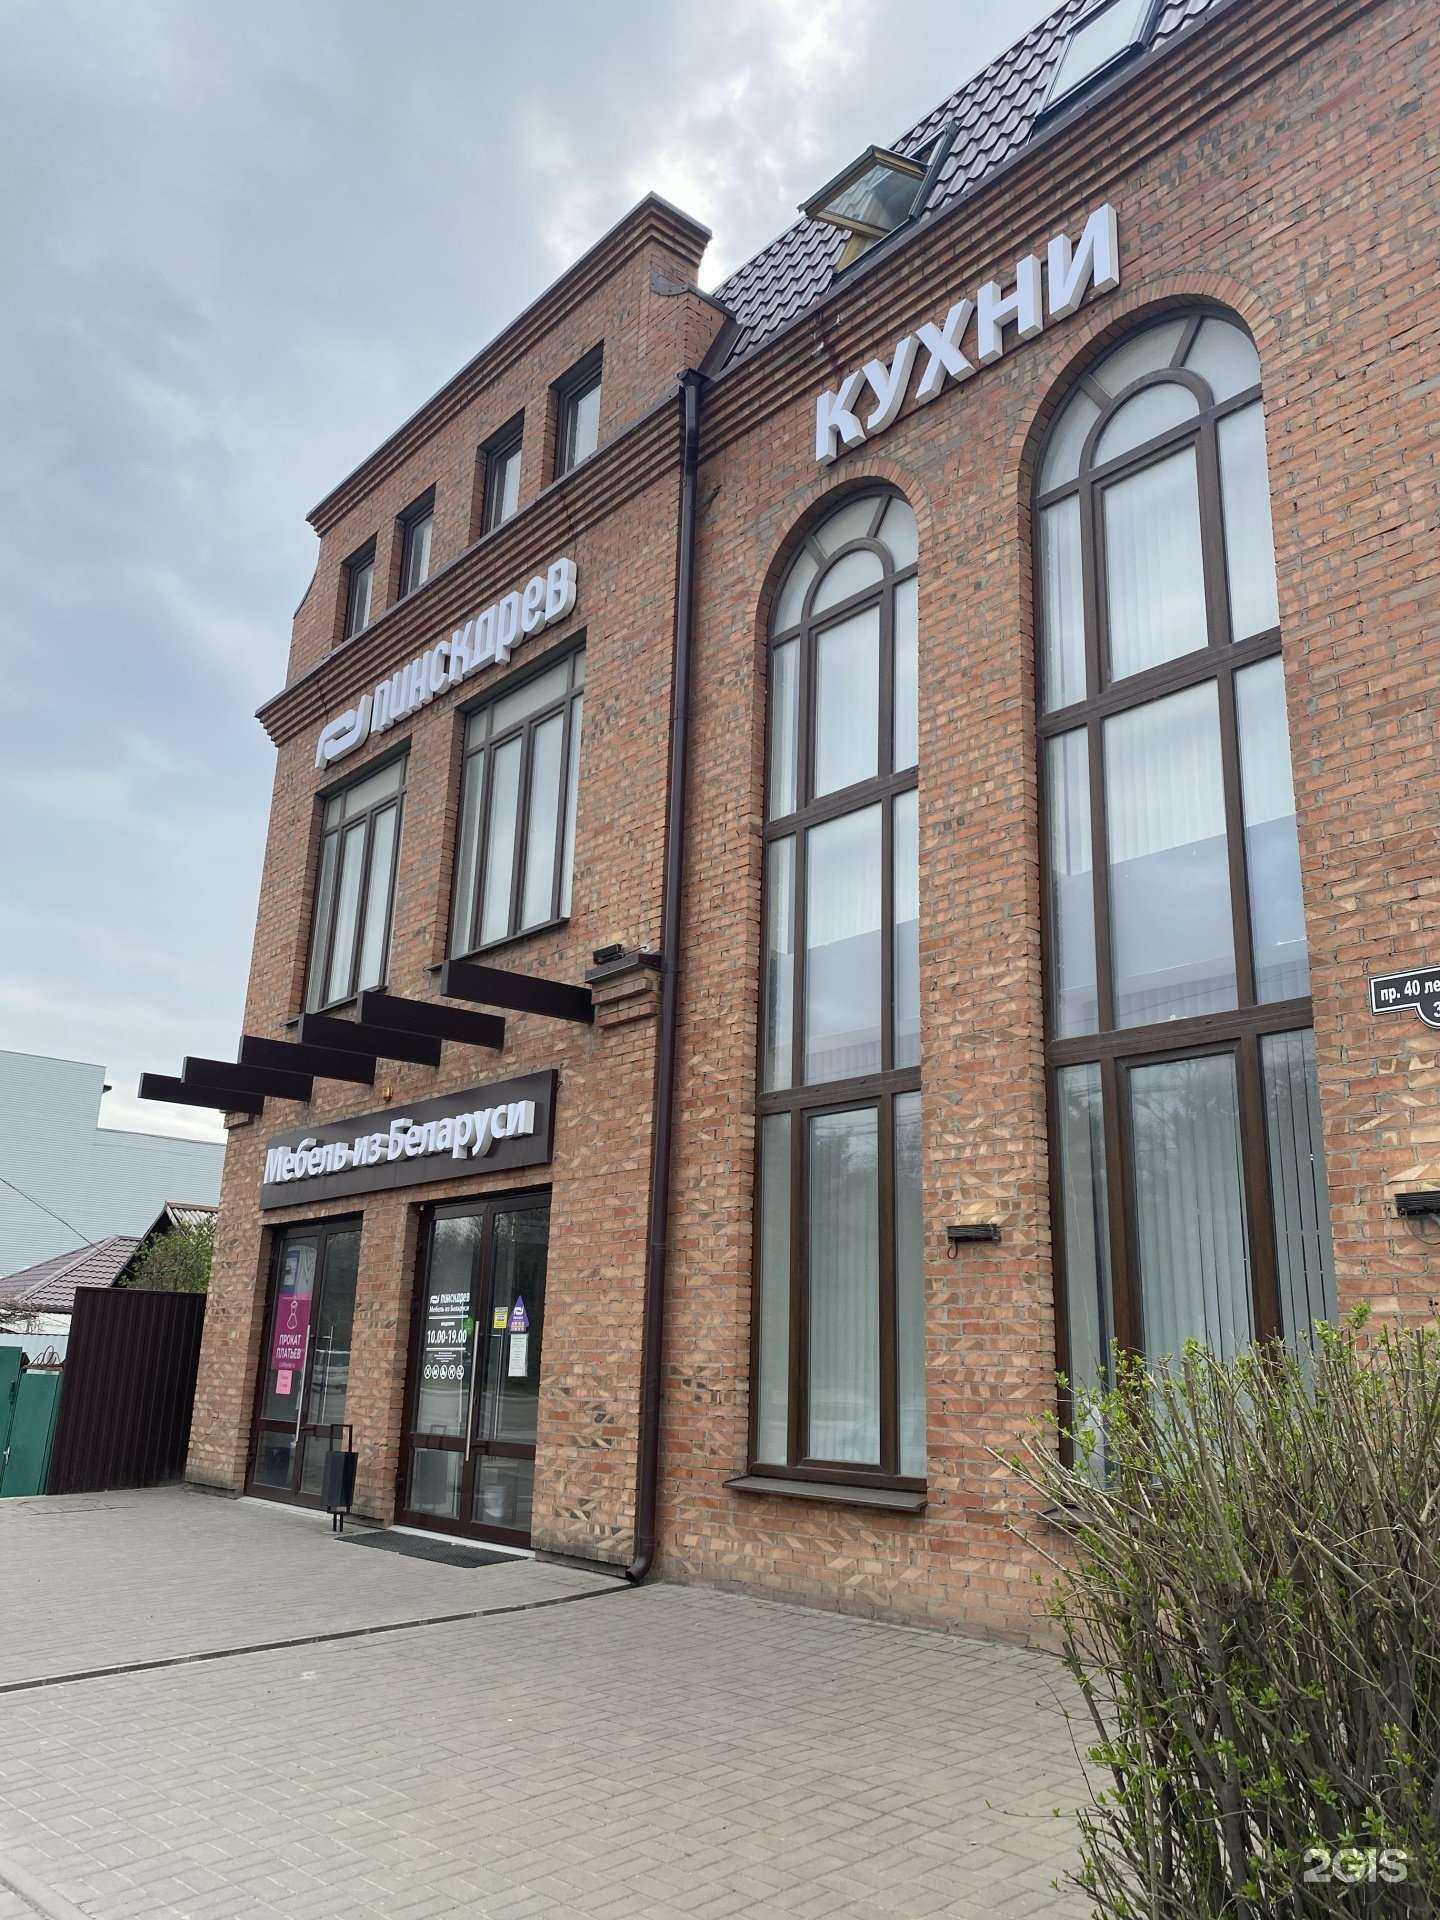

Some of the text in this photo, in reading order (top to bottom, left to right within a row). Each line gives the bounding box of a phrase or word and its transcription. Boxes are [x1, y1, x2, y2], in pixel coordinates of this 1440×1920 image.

[815, 203, 1119, 466] КУХНИ
[1381, 988, 1400, 1003] пр.
[1404, 980, 1420, 996] 40
[263, 1100, 536, 1185] Мебель из Беларуси
[279, 1335, 301, 1346] ПРОКАТ
[427, 1330, 467, 1344] 10.00-19.00
[276, 1348, 301, 1360] ПЛАТЬЕВ
